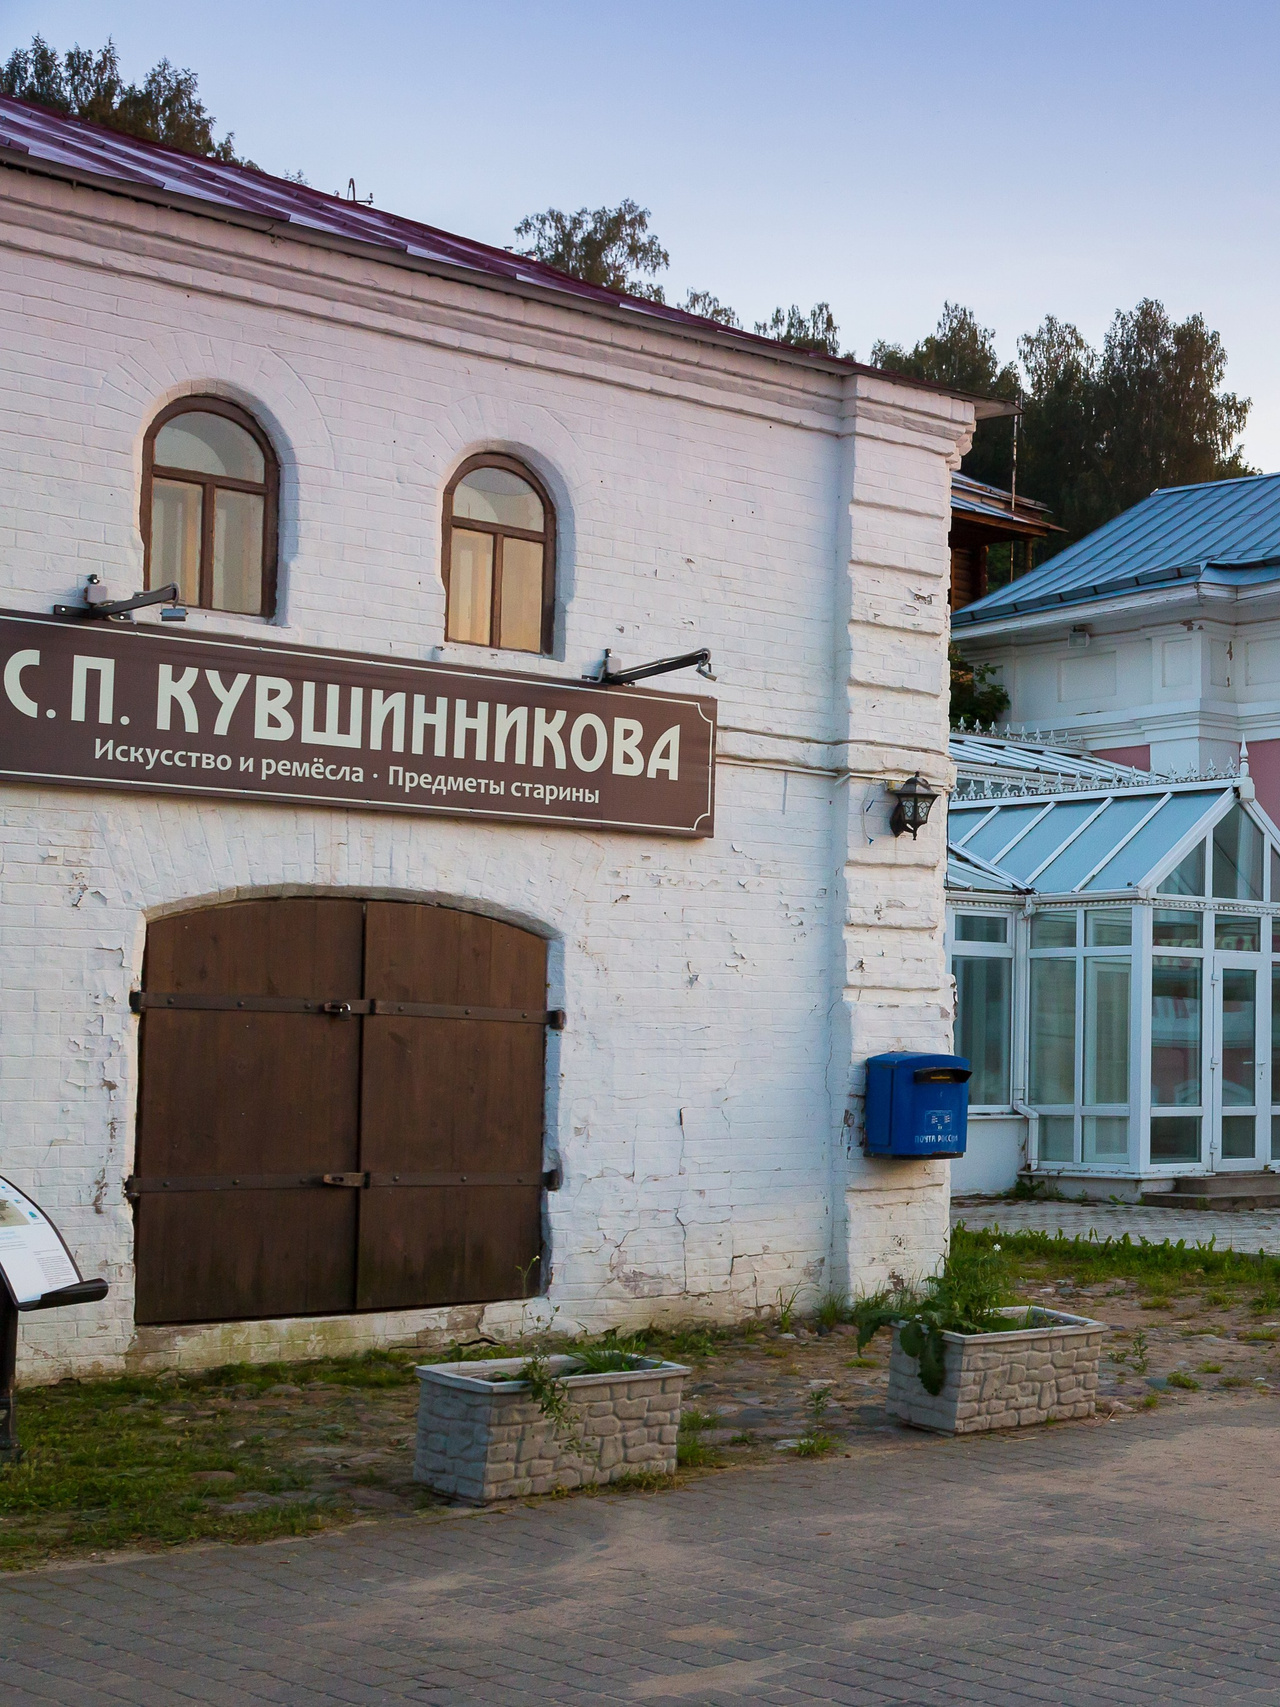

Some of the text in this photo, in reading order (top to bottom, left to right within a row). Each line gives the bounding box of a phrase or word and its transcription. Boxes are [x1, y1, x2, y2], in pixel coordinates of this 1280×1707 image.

[156, 663, 681, 781] КУВШИННИКОВА
[94, 738, 600, 805] Искусство и ремёсла Предметы старины
